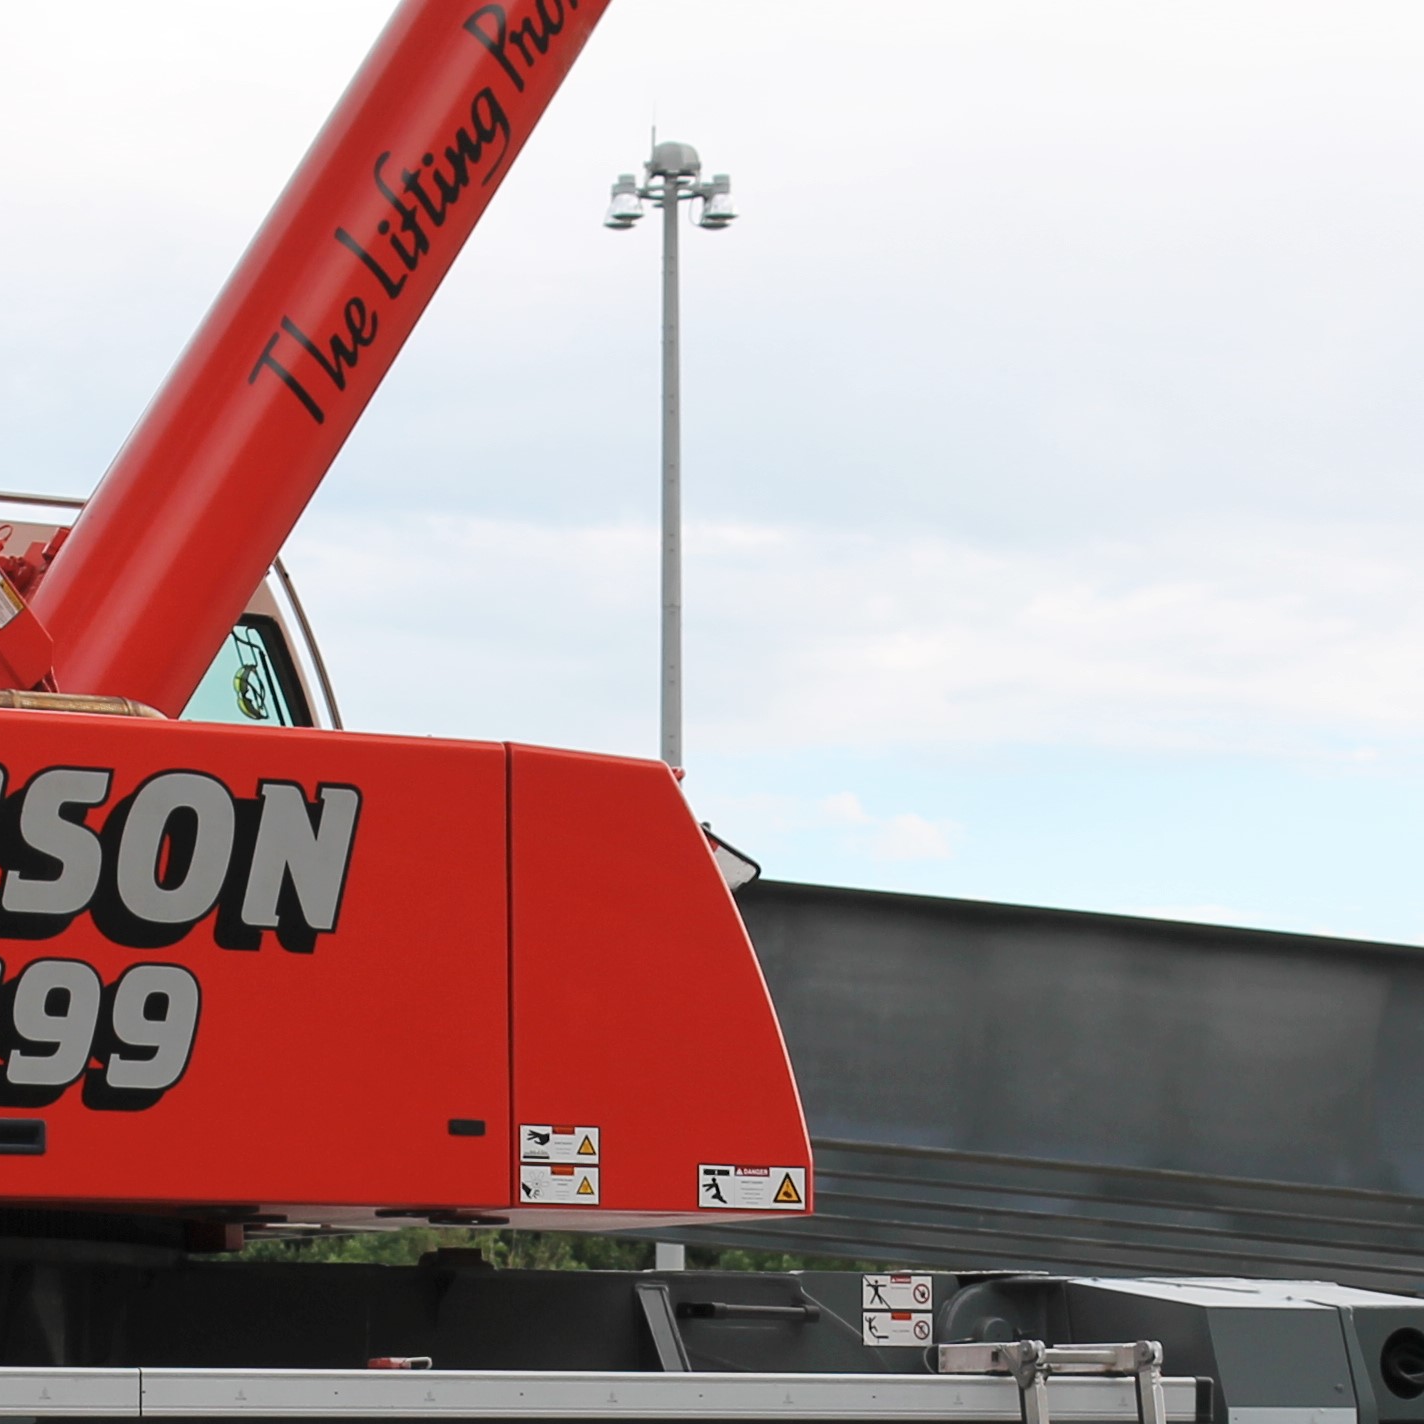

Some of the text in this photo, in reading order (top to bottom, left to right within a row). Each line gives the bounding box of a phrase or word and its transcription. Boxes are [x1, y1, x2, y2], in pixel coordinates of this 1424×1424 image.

[247, 0, 580, 425] The Lifting Pro
[743, 1167, 769, 1176] DANGER
